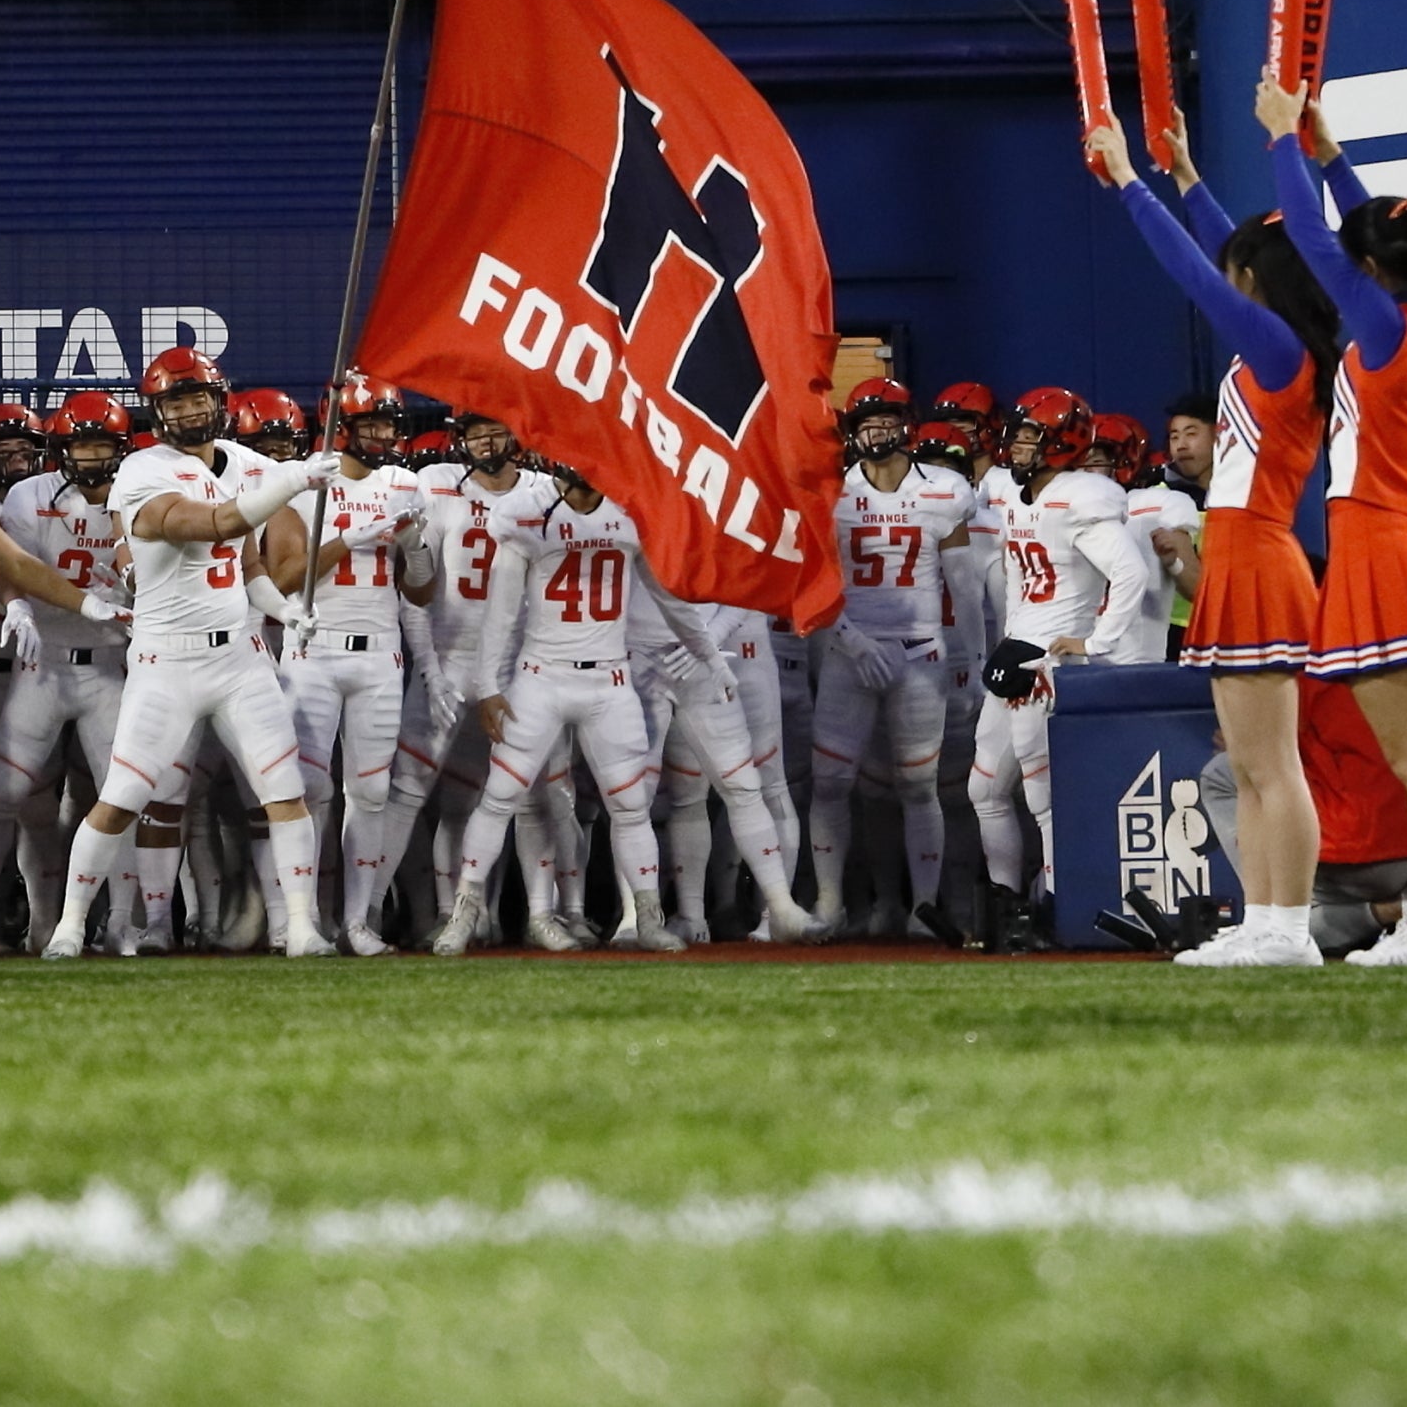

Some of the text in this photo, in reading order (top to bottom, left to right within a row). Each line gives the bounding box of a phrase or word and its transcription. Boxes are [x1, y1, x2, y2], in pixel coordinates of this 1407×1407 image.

[1267, 19, 1285, 83] ARM
[458, 250, 804, 564] FOOTBALL
[338, 501, 386, 514] ORANGE
[855, 496, 868, 511] H
[861, 513, 909, 524] ORANGE
[559, 522, 573, 540] H
[77, 537, 116, 549] ORANG
[565, 538, 614, 552] ORANGE
[849, 526, 922, 587] 57
[544, 549, 626, 623] 40
